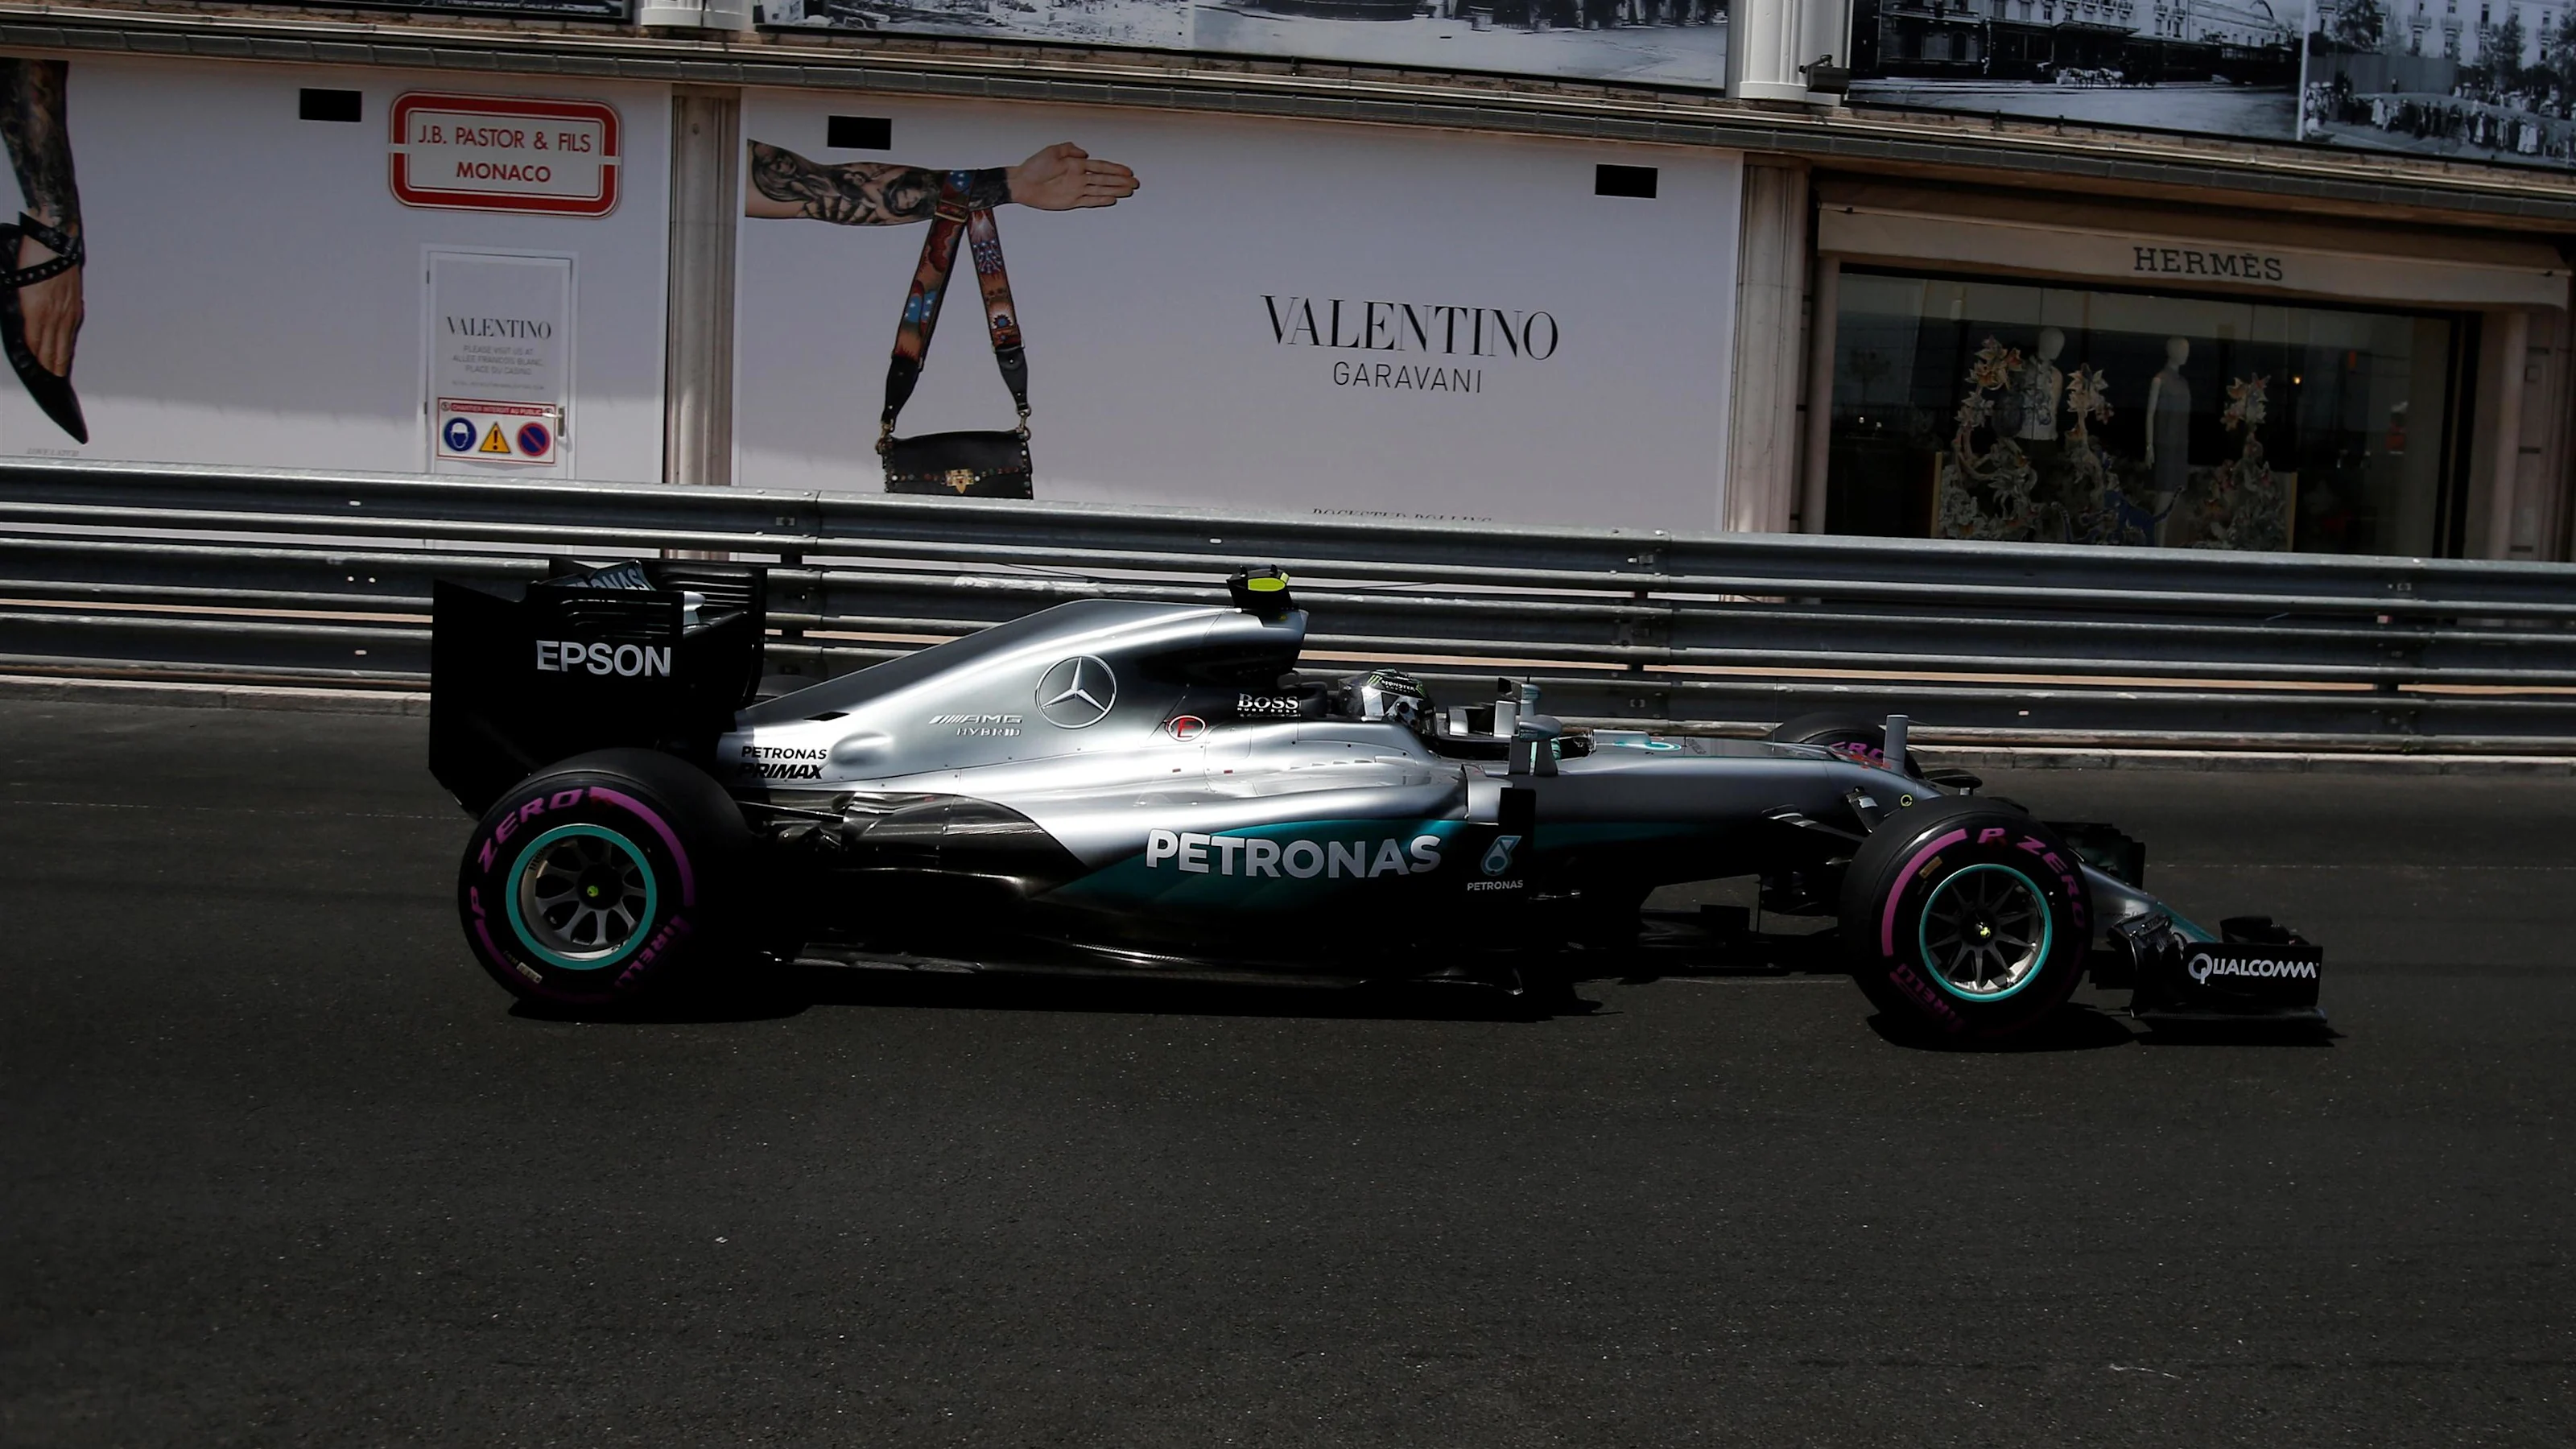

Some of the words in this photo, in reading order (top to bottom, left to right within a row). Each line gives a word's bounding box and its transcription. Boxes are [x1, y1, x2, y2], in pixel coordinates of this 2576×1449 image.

[418, 125, 448, 144] J.B.
[455, 126, 525, 149] PASTOR
[534, 131, 550, 151] &
[558, 133, 592, 153] FILS
[456, 161, 551, 182] MONACO
[2133, 247, 2283, 281] HERMÈS
[447, 316, 551, 340] VALENTINO
[1260, 295, 1558, 360] VALENTINO
[1333, 361, 1481, 393] GARAVANI
[536, 639, 671, 678] EPSON
[1237, 692, 1299, 709] BOSS
[1381, 679, 1416, 692] MONSTER
[956, 727, 1022, 737] HYBRID
[962, 714, 1024, 724] AMG
[741, 745, 828, 761] PETRONAS
[739, 763, 824, 781] PRIMAX
[477, 788, 584, 874] ZERO
[1146, 828, 1442, 880] PETRONAS
[1467, 878, 1525, 892] PETRONAS
[1976, 828, 2007, 844] P
[2015, 835, 2086, 930] ZERO
[469, 886, 486, 918] P
[2188, 952, 2317, 985] QUALCOMM
[1889, 963, 1966, 1034] PIRELLI
